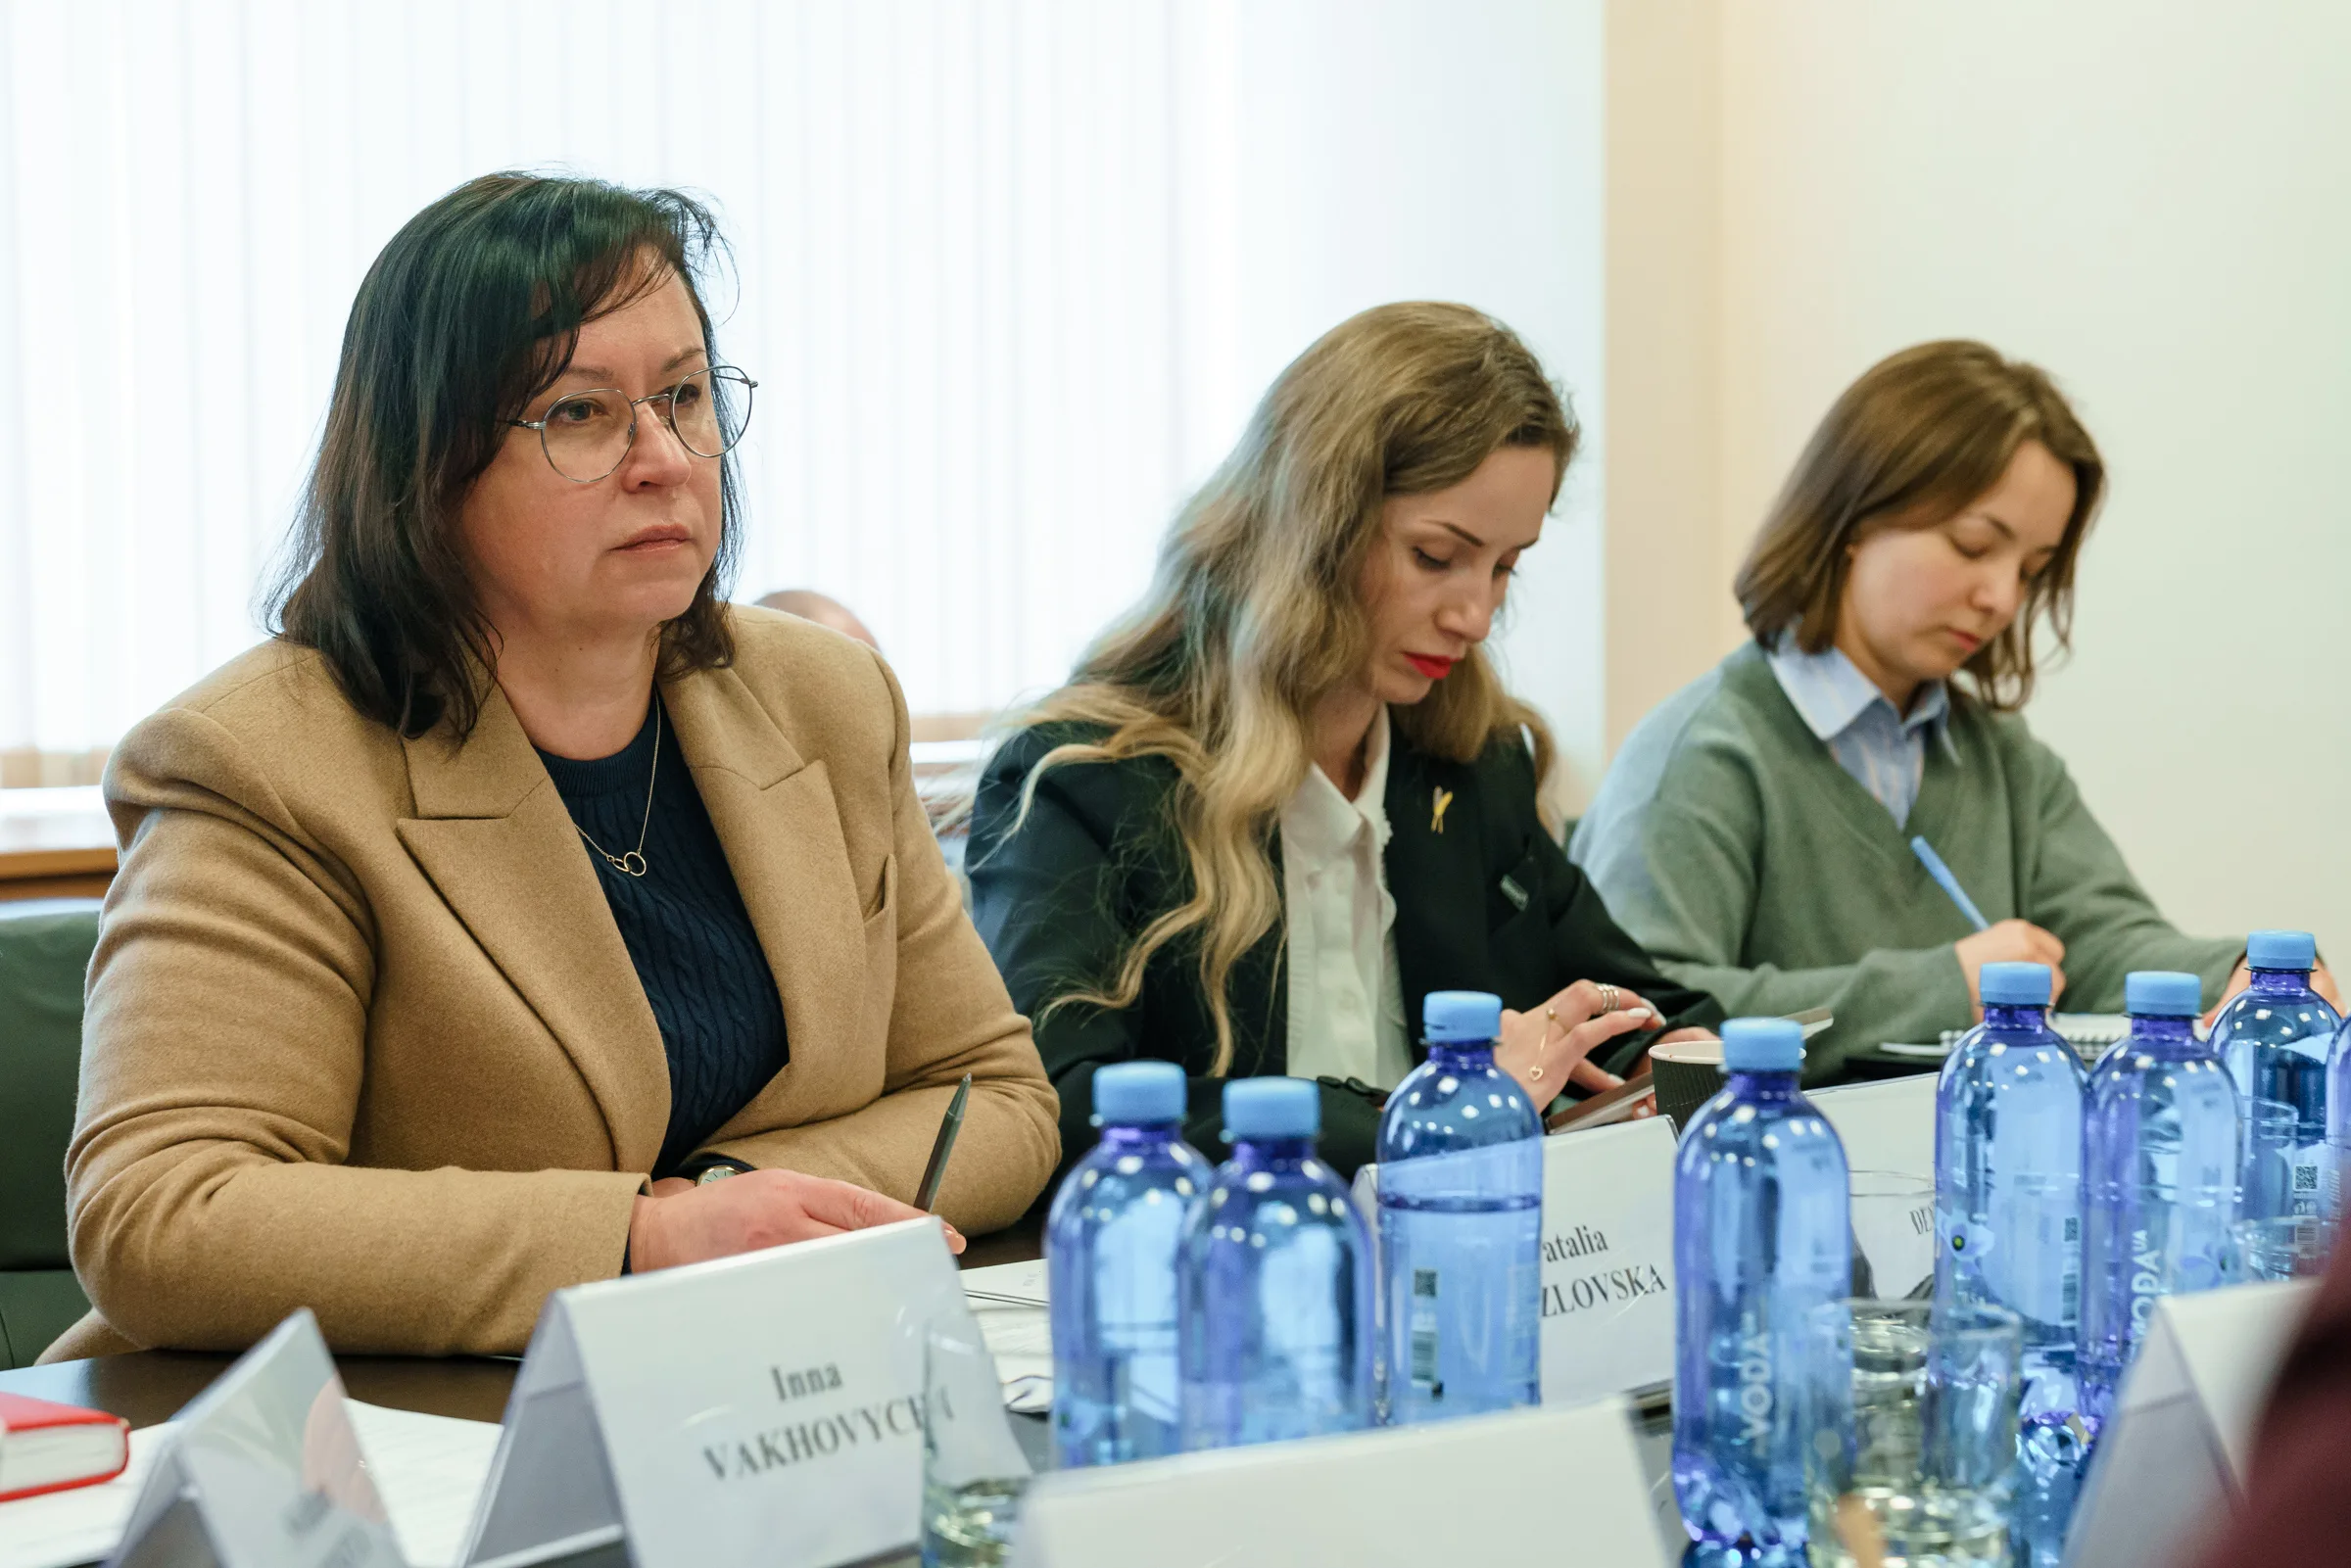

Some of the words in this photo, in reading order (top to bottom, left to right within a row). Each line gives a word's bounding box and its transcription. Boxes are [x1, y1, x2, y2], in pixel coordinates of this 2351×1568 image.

[1542, 1224, 1608, 1263] atalia
[1542, 1262, 1667, 1317] ZLOVSKA
[771, 1362, 843, 1402] Inna
[1740, 1332, 1772, 1439] VODA
